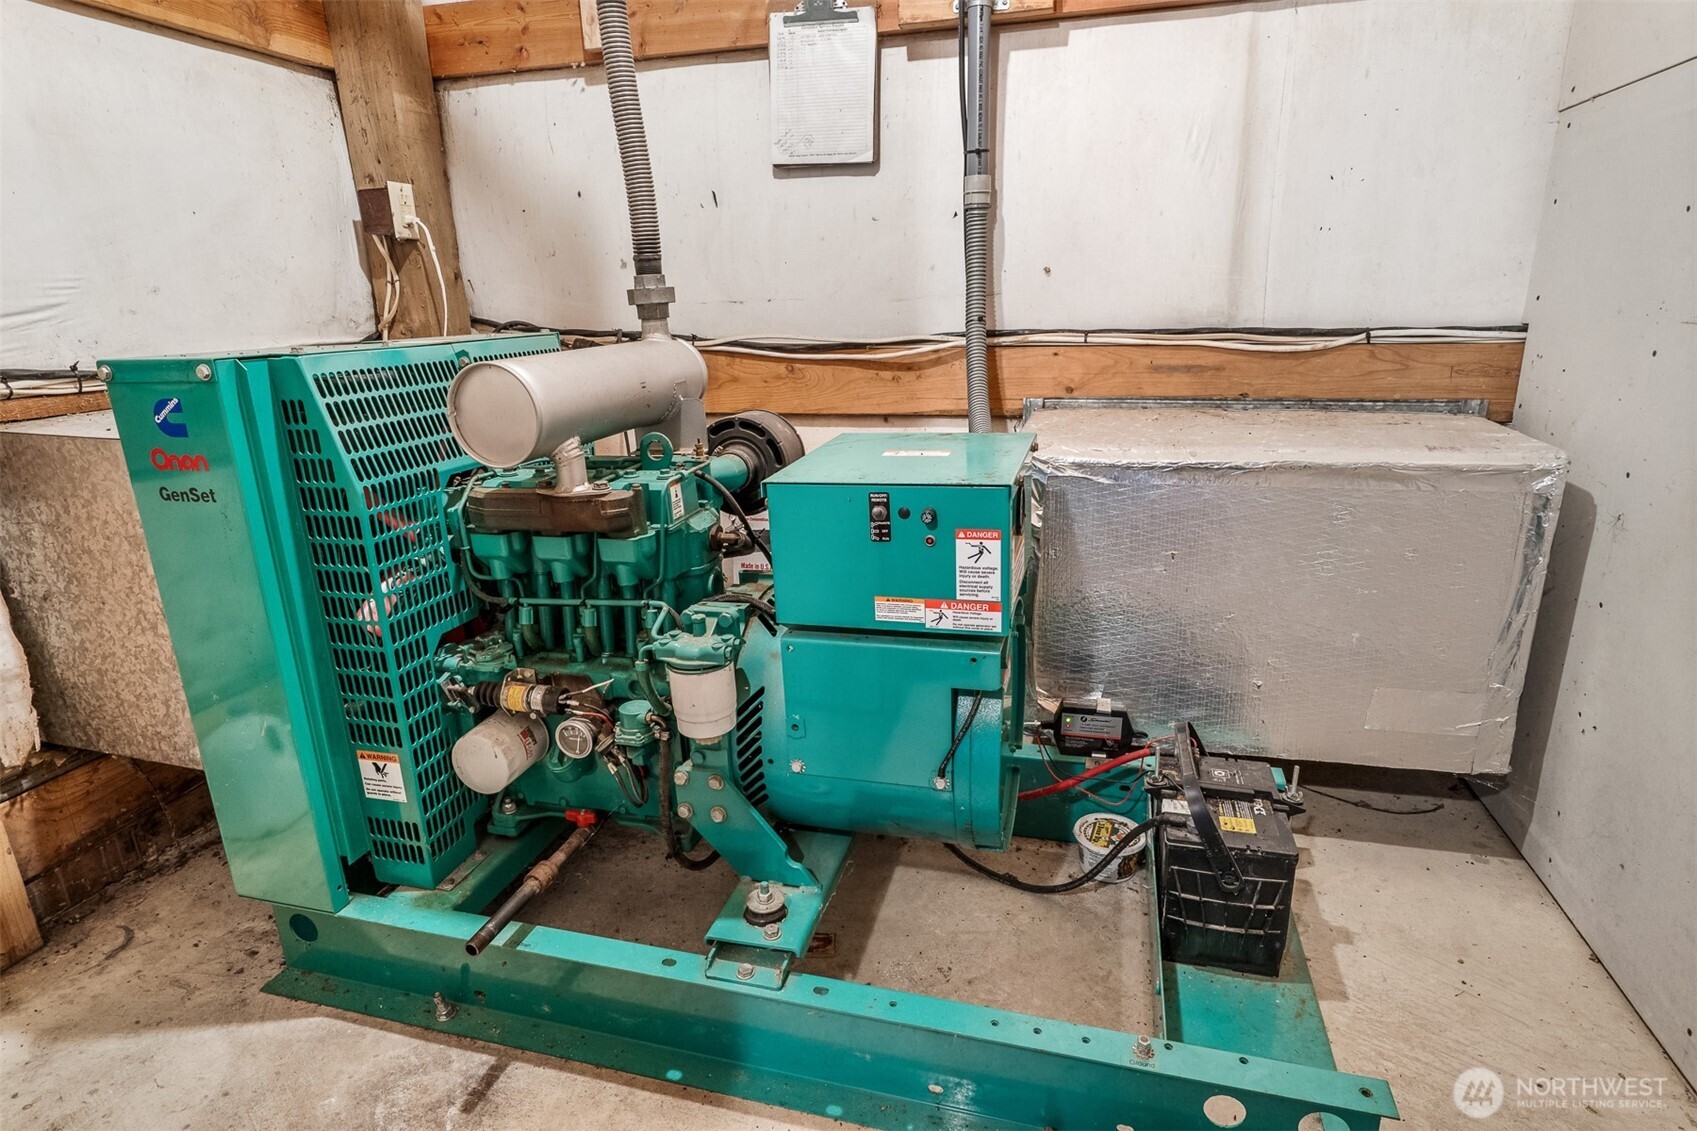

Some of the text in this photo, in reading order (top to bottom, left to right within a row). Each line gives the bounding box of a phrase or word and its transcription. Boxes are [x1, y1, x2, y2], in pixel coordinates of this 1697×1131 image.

[154, 397, 179, 424] Cummins
[150, 447, 210, 472] Onan
[159, 486, 217, 503] GenSet
[950, 602, 989, 611] DANGER
[366, 753, 397, 762] WARNING
[1128, 1059, 1156, 1068] Ground
